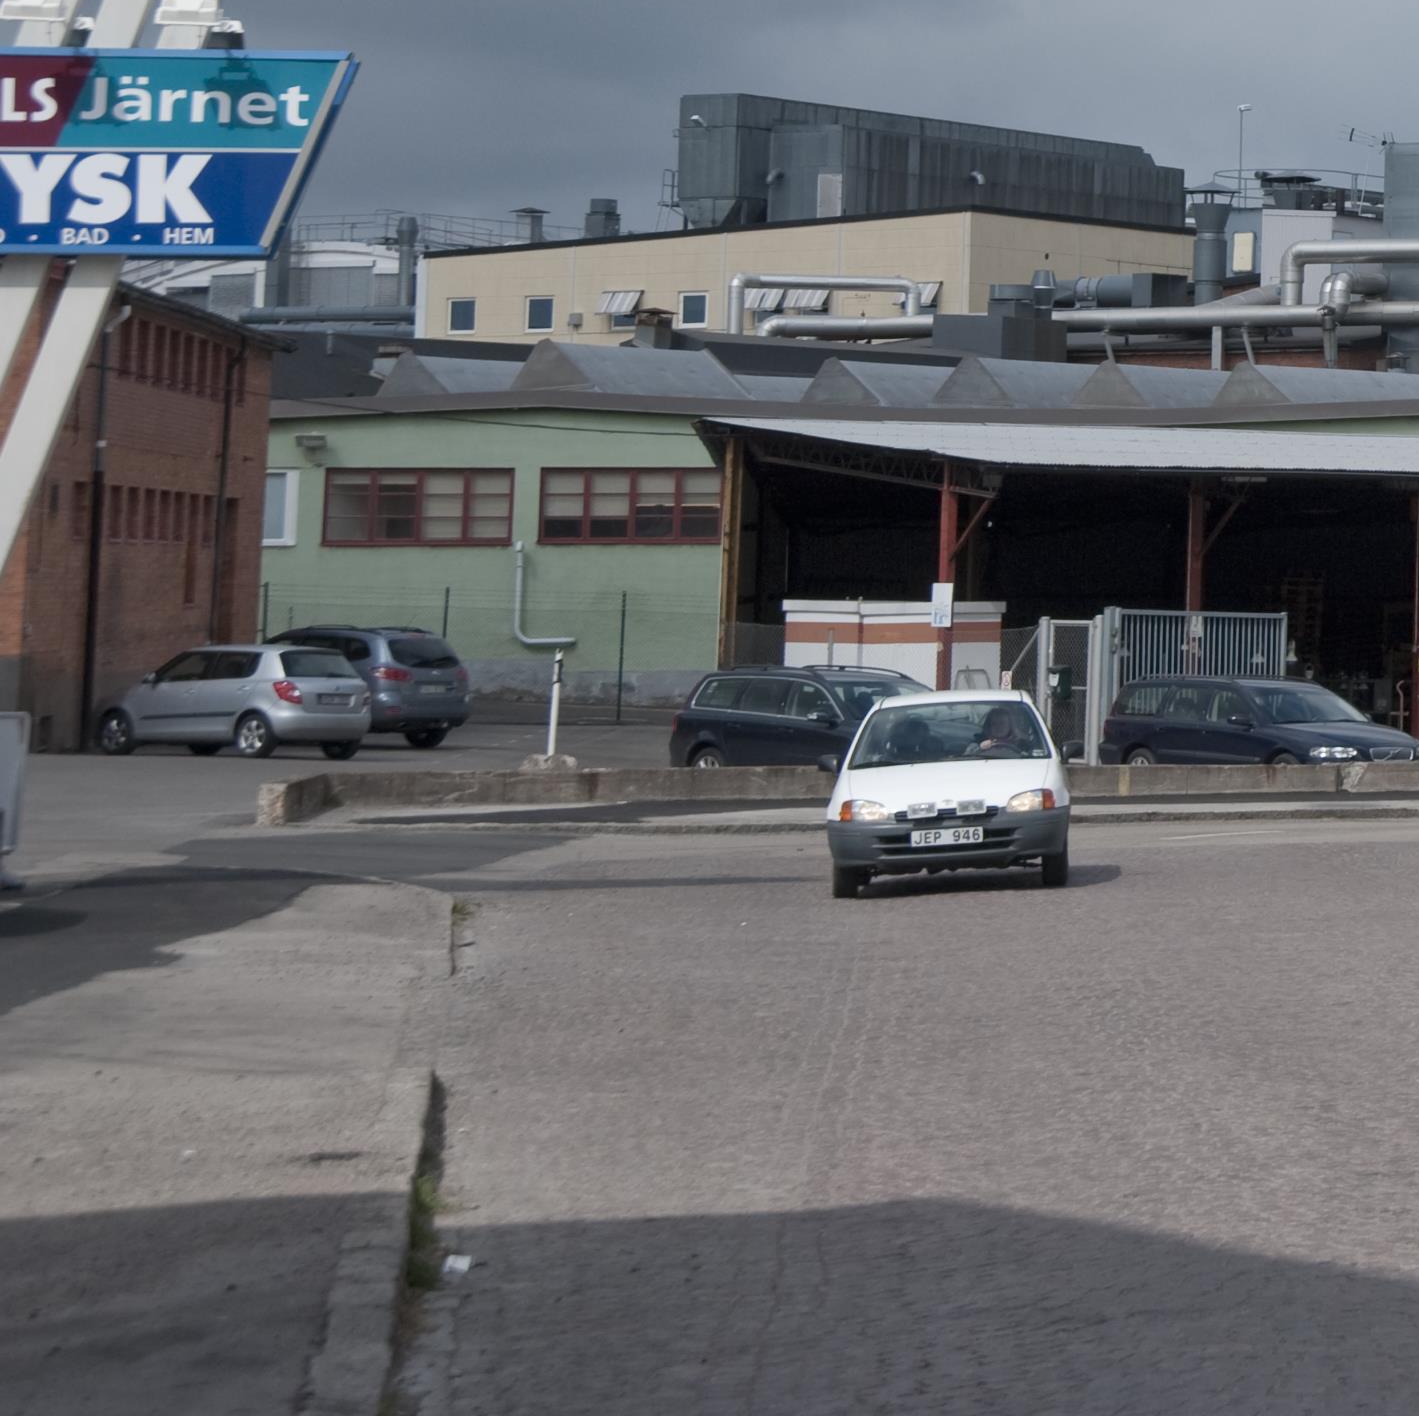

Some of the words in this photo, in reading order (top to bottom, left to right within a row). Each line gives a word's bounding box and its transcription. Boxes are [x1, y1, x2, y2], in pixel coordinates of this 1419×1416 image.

[0, 77, 58, 122] LS
[79, 75, 310, 127] Järnet
[0, 153, 214, 224] YSK
[61, 227, 110, 245] BAD
[163, 227, 215, 245] HEM
[914, 831, 941, 845] JEP
[952, 828, 981, 842] 946
